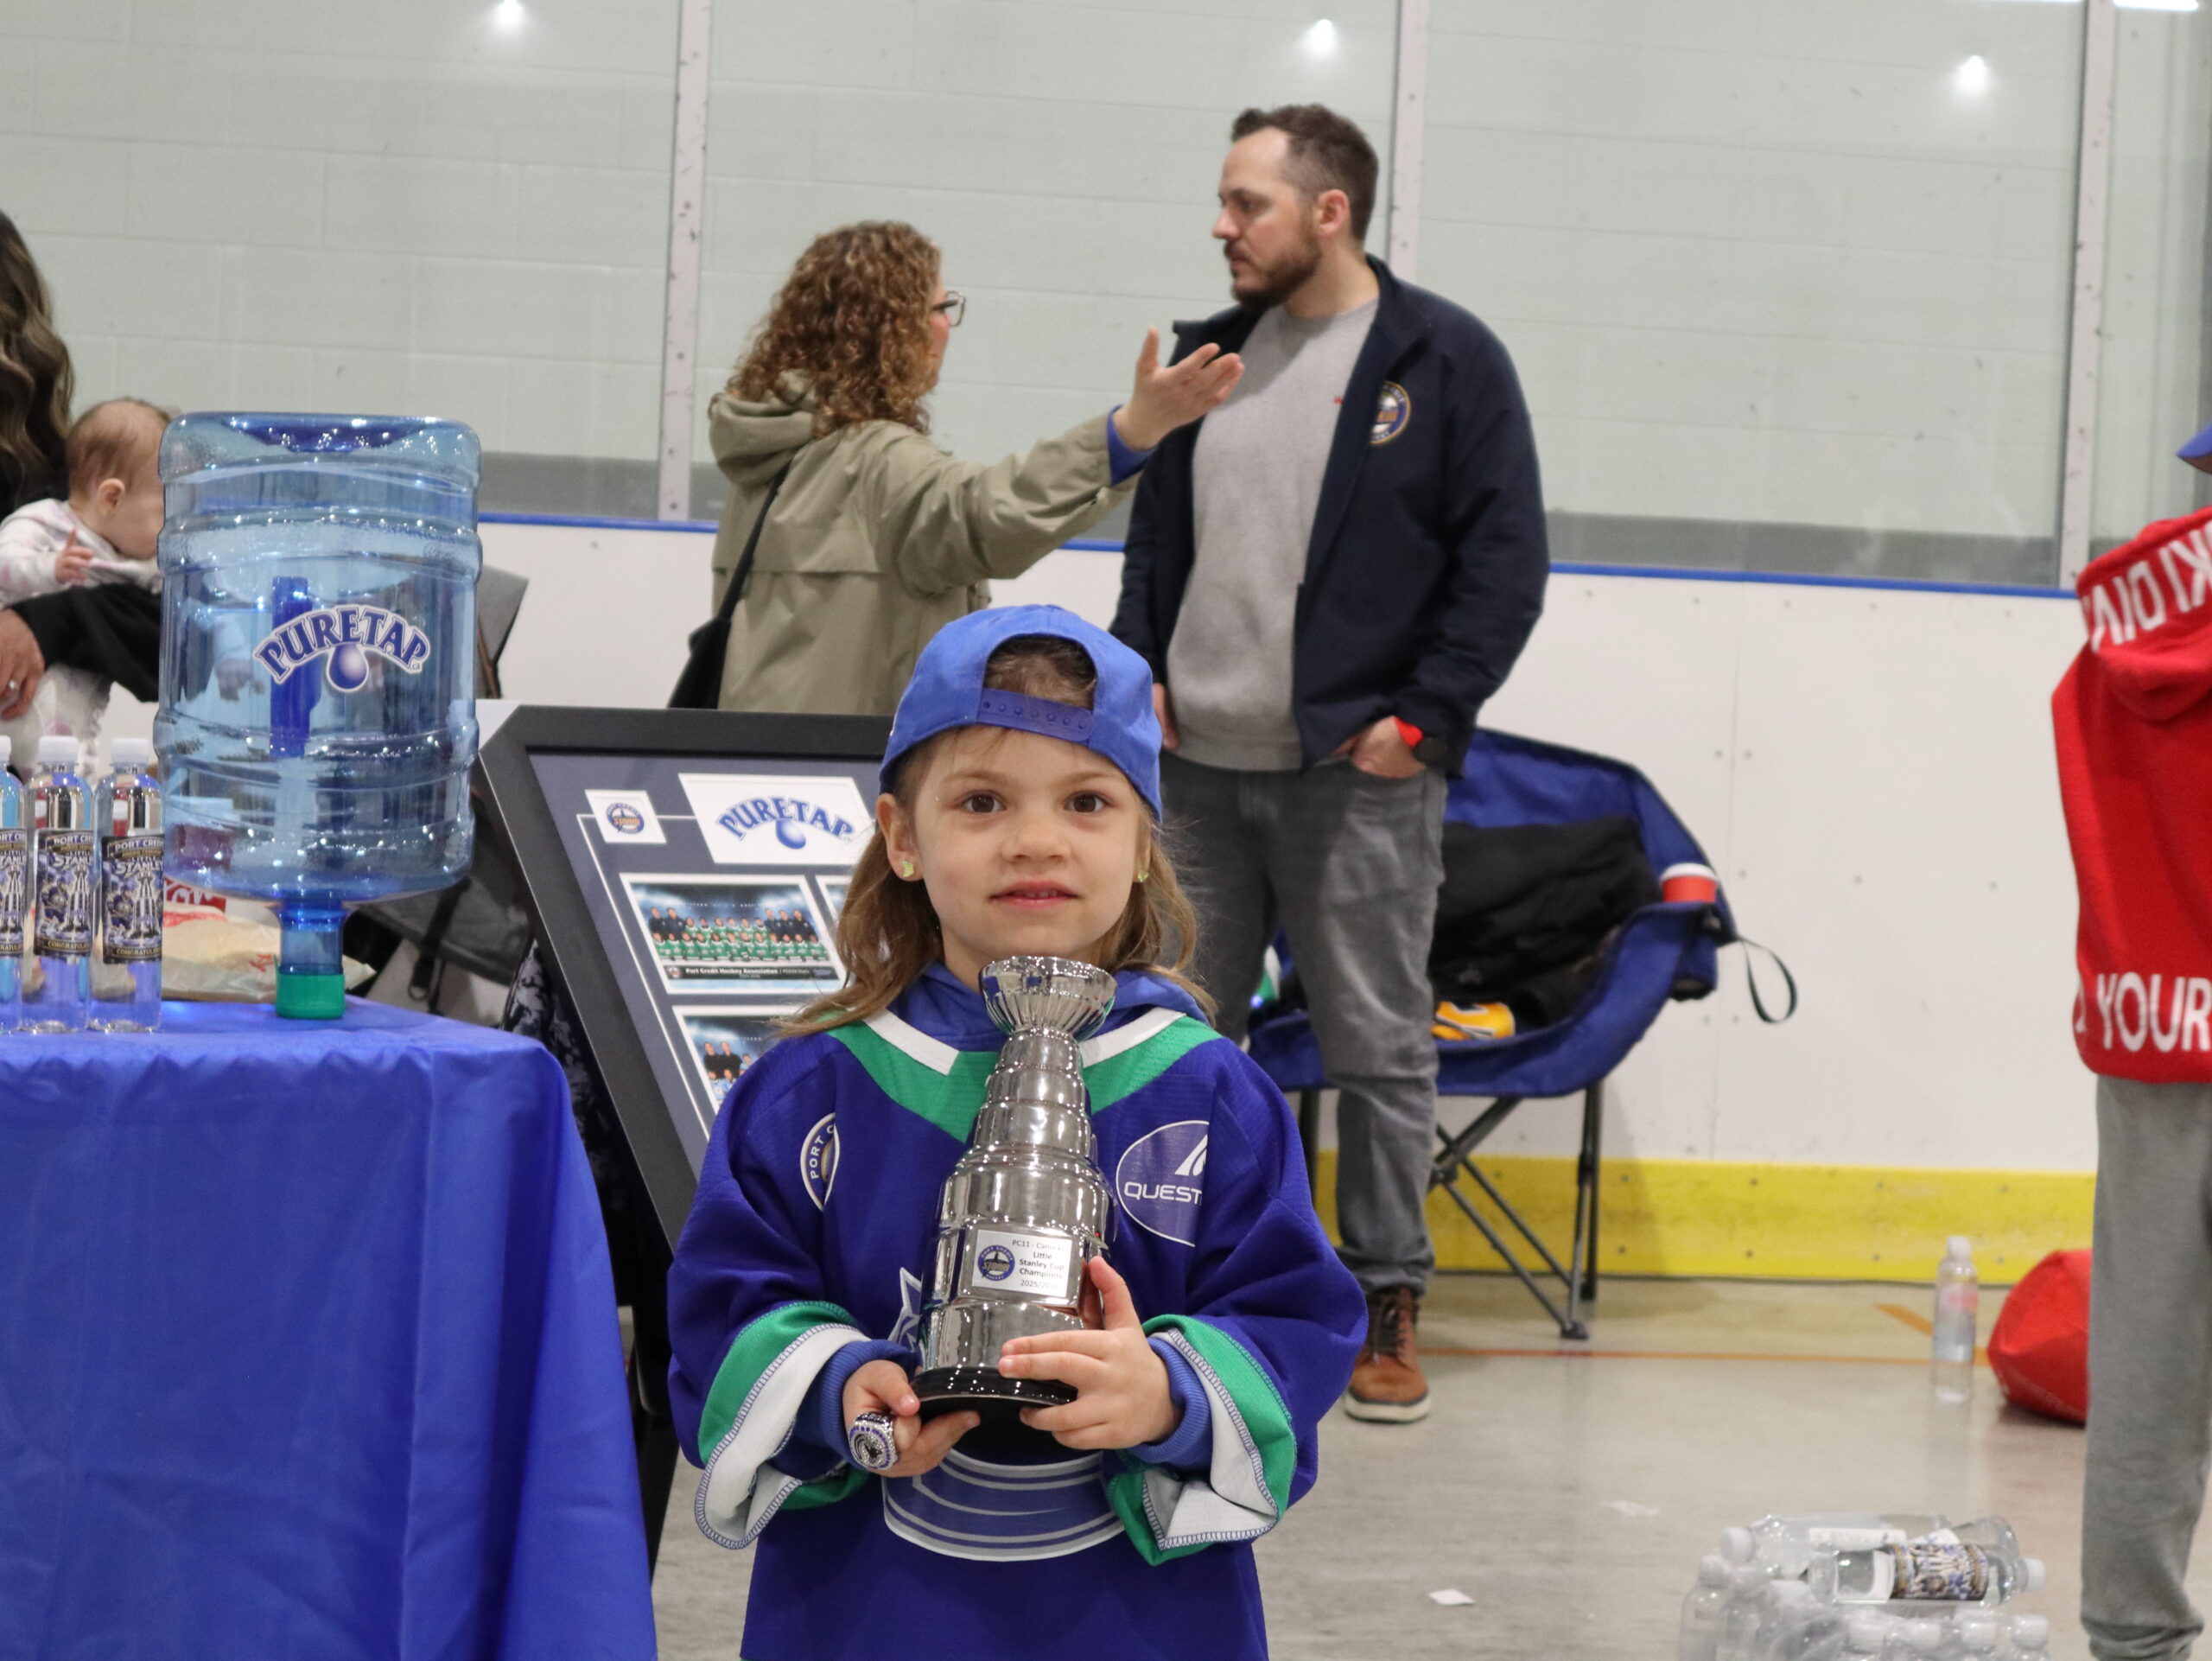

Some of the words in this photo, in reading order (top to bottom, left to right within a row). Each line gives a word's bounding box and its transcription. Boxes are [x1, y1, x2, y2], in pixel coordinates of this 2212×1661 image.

[254, 607, 429, 681] PURETAP
[715, 795, 855, 841] PURETAP
[115, 841, 141, 851] PORT
[2097, 971, 2212, 1052] YOUR
[810, 1136, 824, 1180] PORT
[1124, 1181, 1202, 1206] QUEST
[1012, 1239, 1030, 1248] PC11
[1019, 1258, 1047, 1270] Stanley
[1049, 1263, 1065, 1271] Cup
[1033, 1251, 1052, 1260] Little
[1019, 1268, 1063, 1279] Champions
